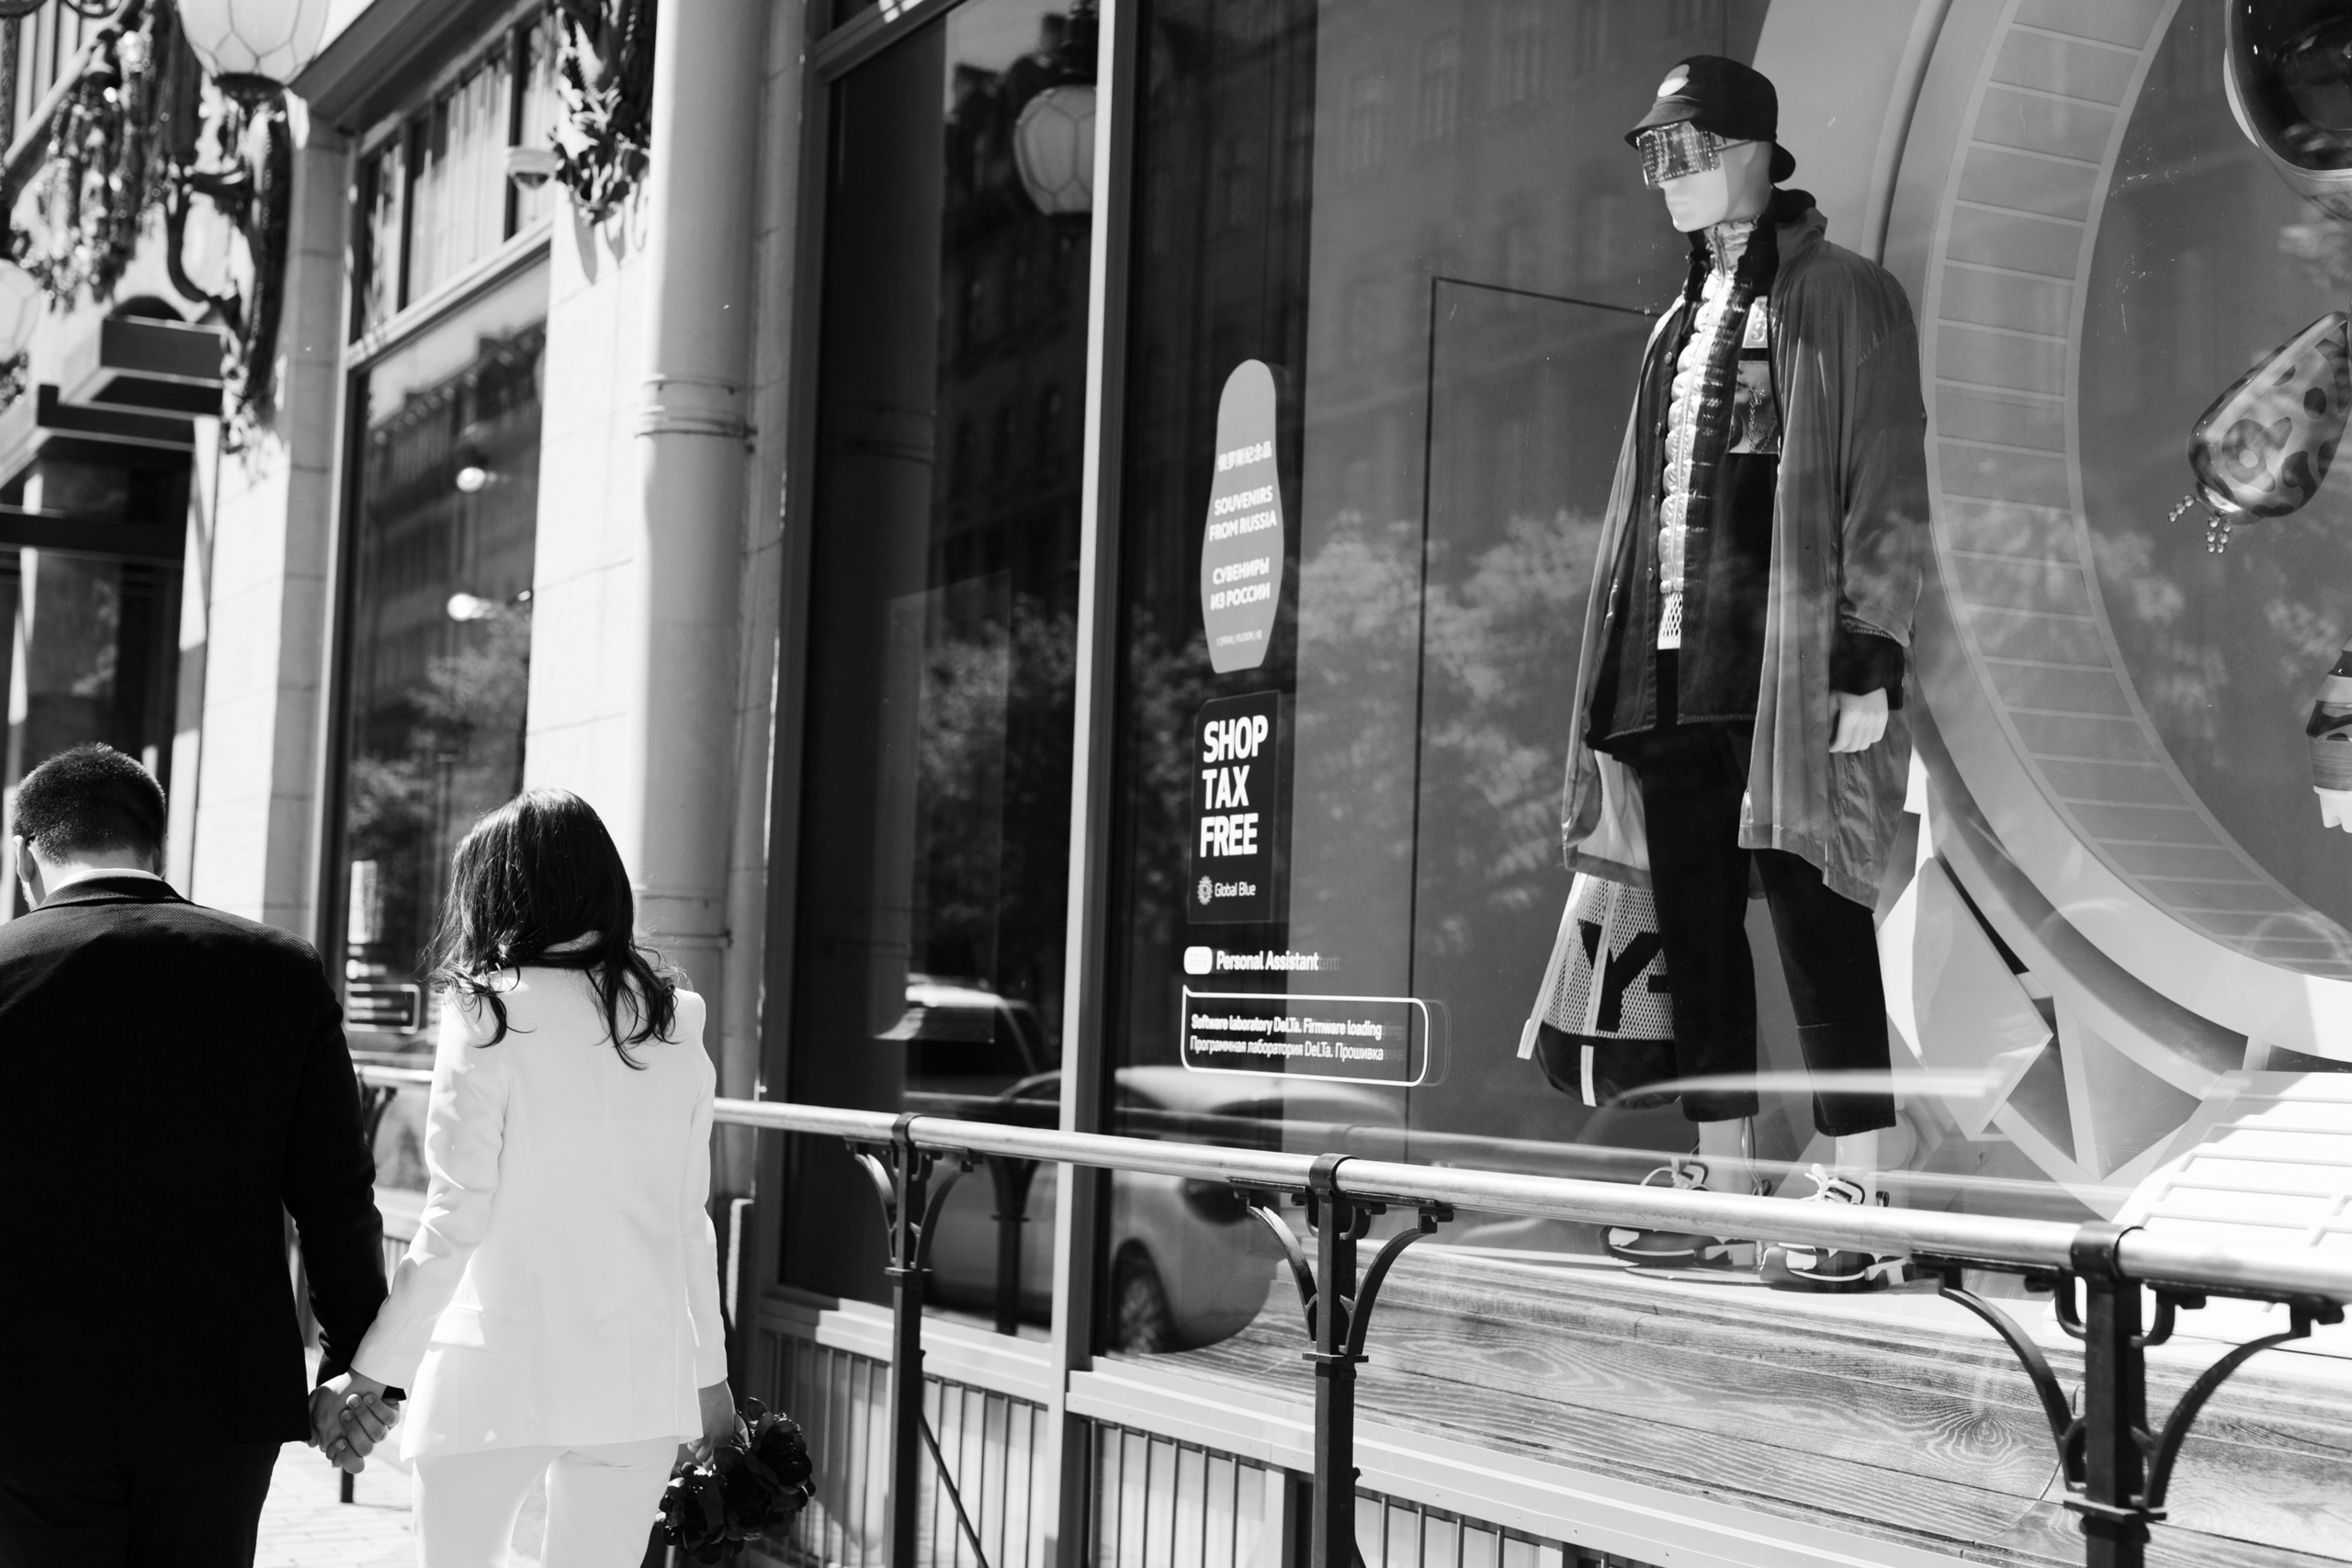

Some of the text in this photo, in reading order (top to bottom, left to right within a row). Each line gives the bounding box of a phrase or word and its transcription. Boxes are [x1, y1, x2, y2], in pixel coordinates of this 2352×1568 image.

[1214, 485, 1273, 516] SOUVENIRS
[1208, 510, 1277, 542] FROM RUSSIA
[1213, 557, 1270, 585] СУВЕНИРЫ
[1210, 581, 1271, 611] ИЗ РОССИИ
[1203, 715, 1269, 763] SHOP
[1202, 765, 1250, 810] TAX
[1200, 813, 1259, 858] FREE
[1215, 881, 1256, 897] Global Blue
[1216, 950, 1264, 970] Personal
[1264, 950, 1319, 971] Assistant
[1191, 1013, 1229, 1031] Software
[1228, 1014, 1273, 1036] laboratory
[1303, 1017, 1347, 1035] Firmware
[1347, 1019, 1383, 1041] loading
[1190, 1034, 1248, 1055] Программная
[1247, 1038, 1304, 1059] лаборатория
[1334, 1042, 1385, 1063] Прошивка
